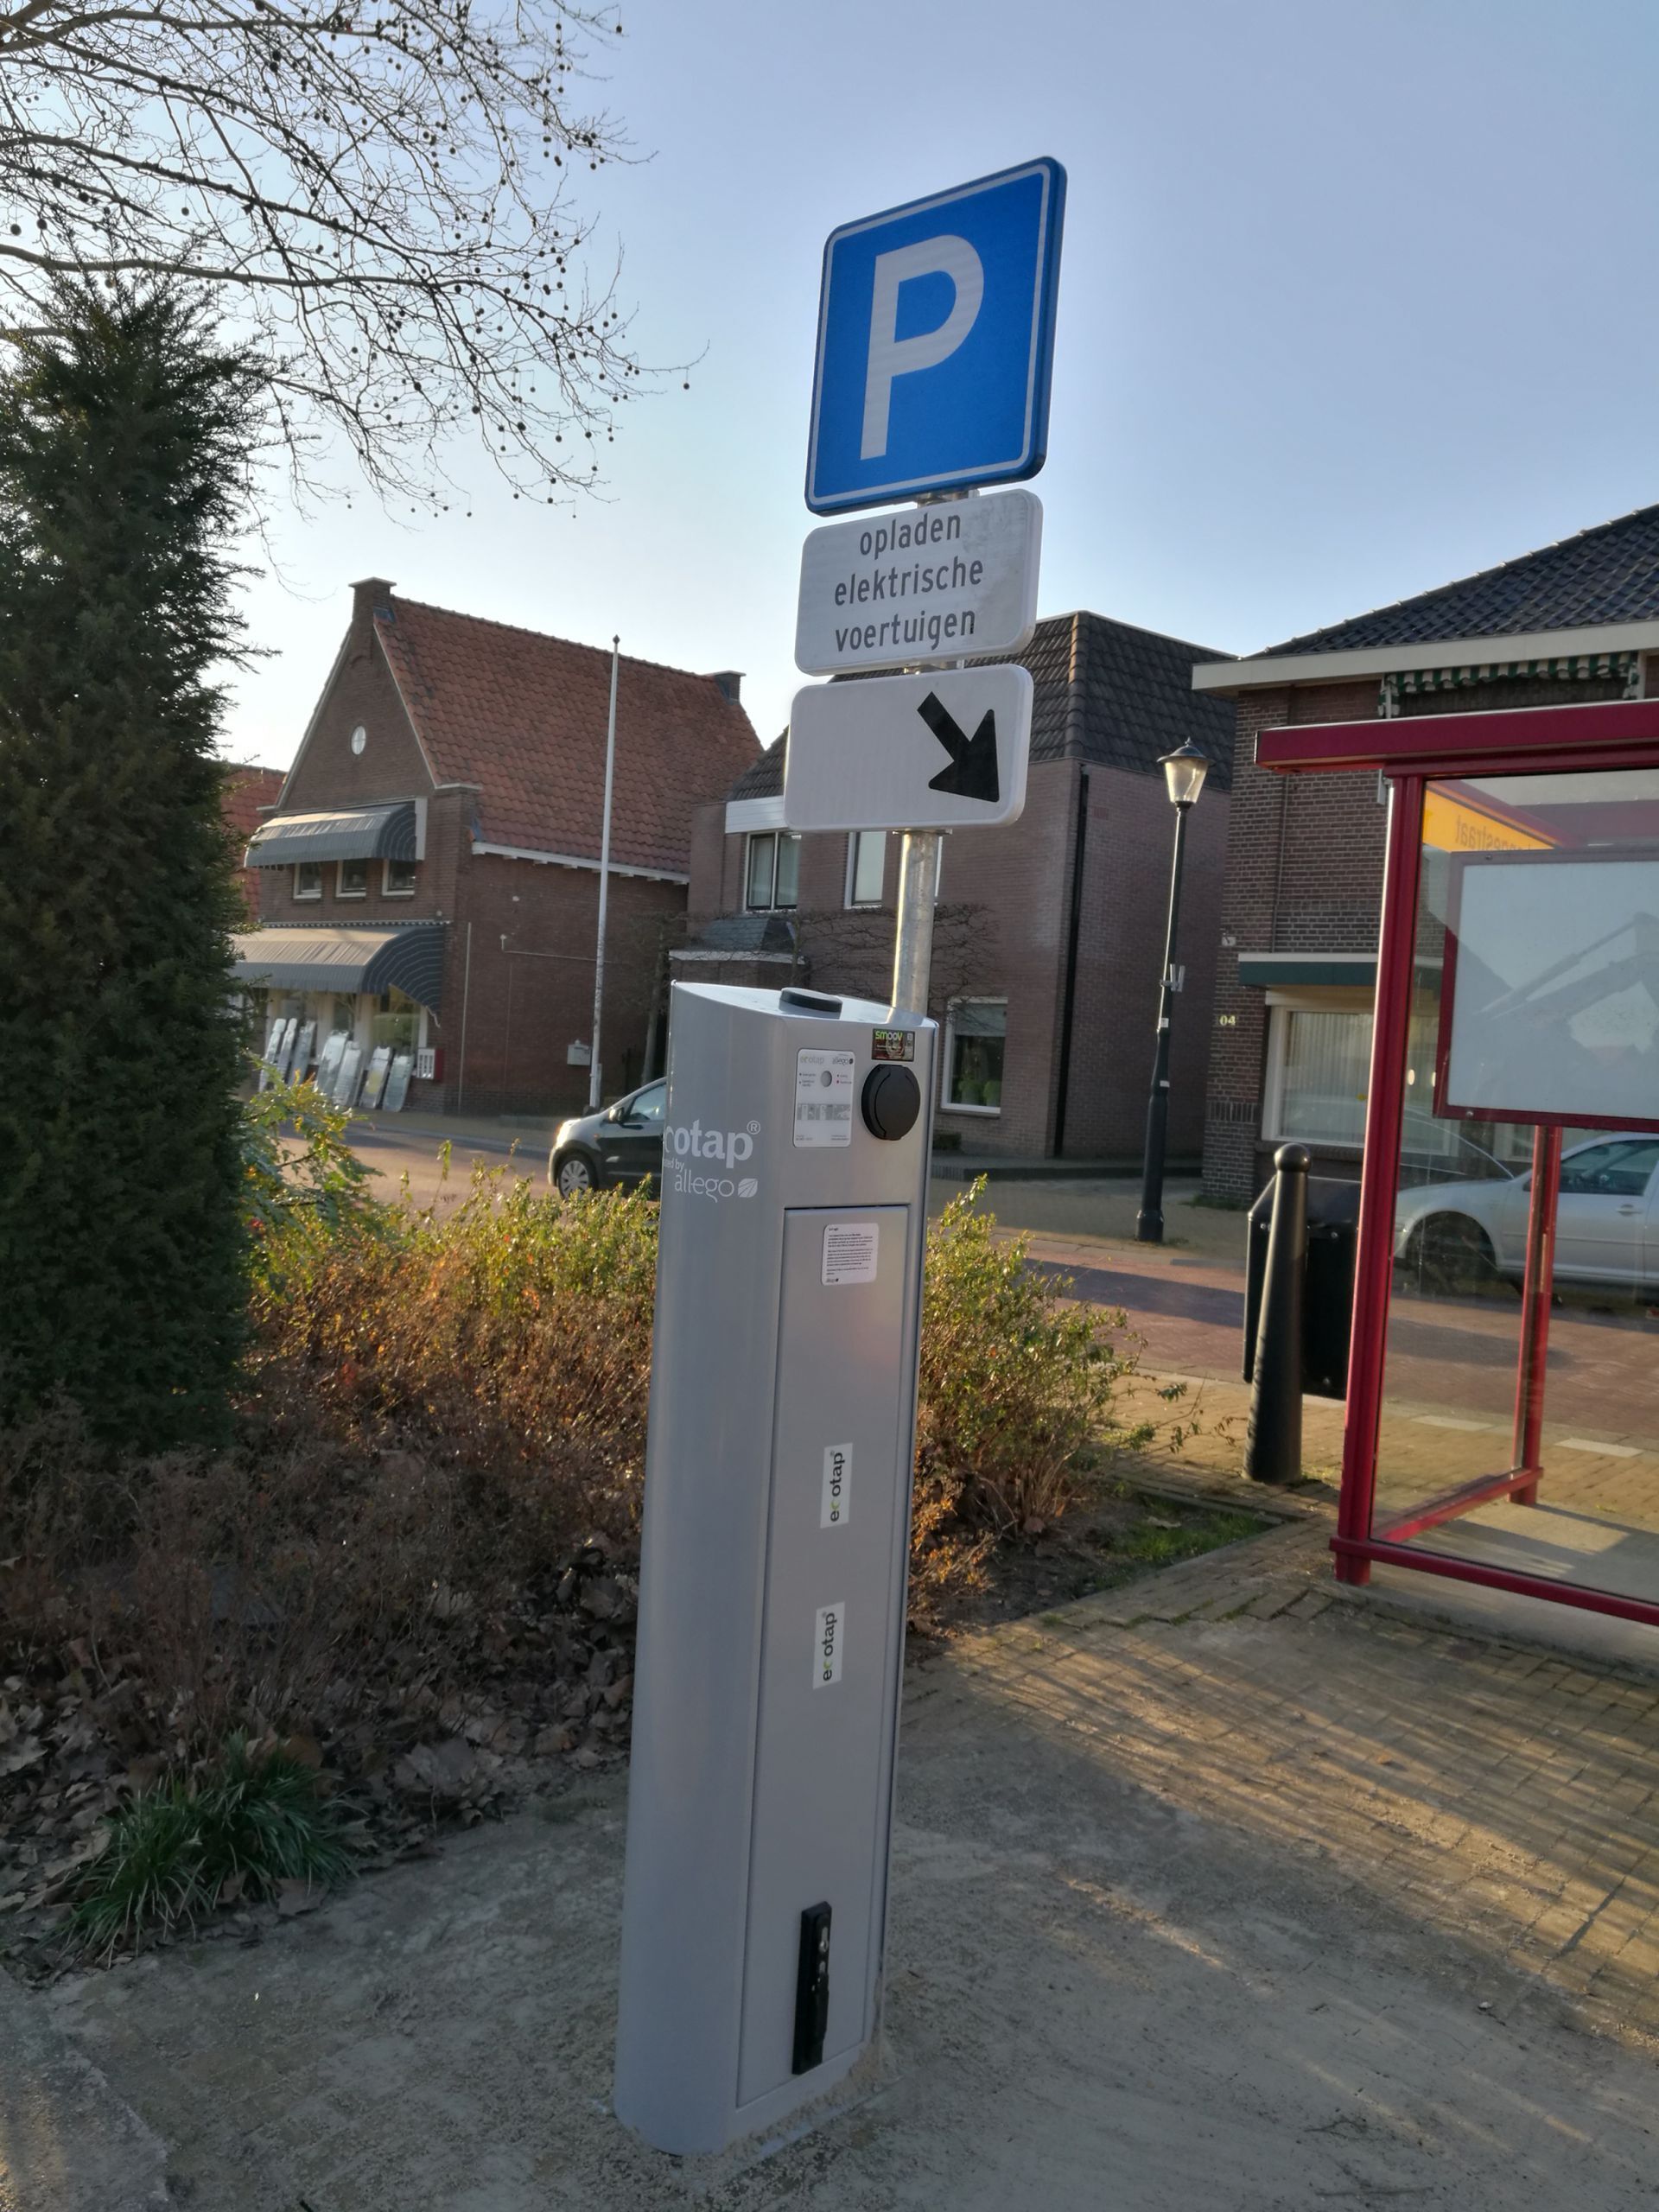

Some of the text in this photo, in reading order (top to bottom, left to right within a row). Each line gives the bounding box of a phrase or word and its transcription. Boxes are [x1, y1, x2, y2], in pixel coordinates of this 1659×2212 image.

[860, 234, 984, 461] P
[860, 512, 961, 560] opladen
[835, 556, 983, 606] elektrische
[836, 610, 976, 652] voertuigen
[674, 1169, 734, 1203] allego
[675, 1158, 685, 1173] by
[830, 1452, 845, 1522] ecotap
[822, 1612, 837, 1681] ecotap
